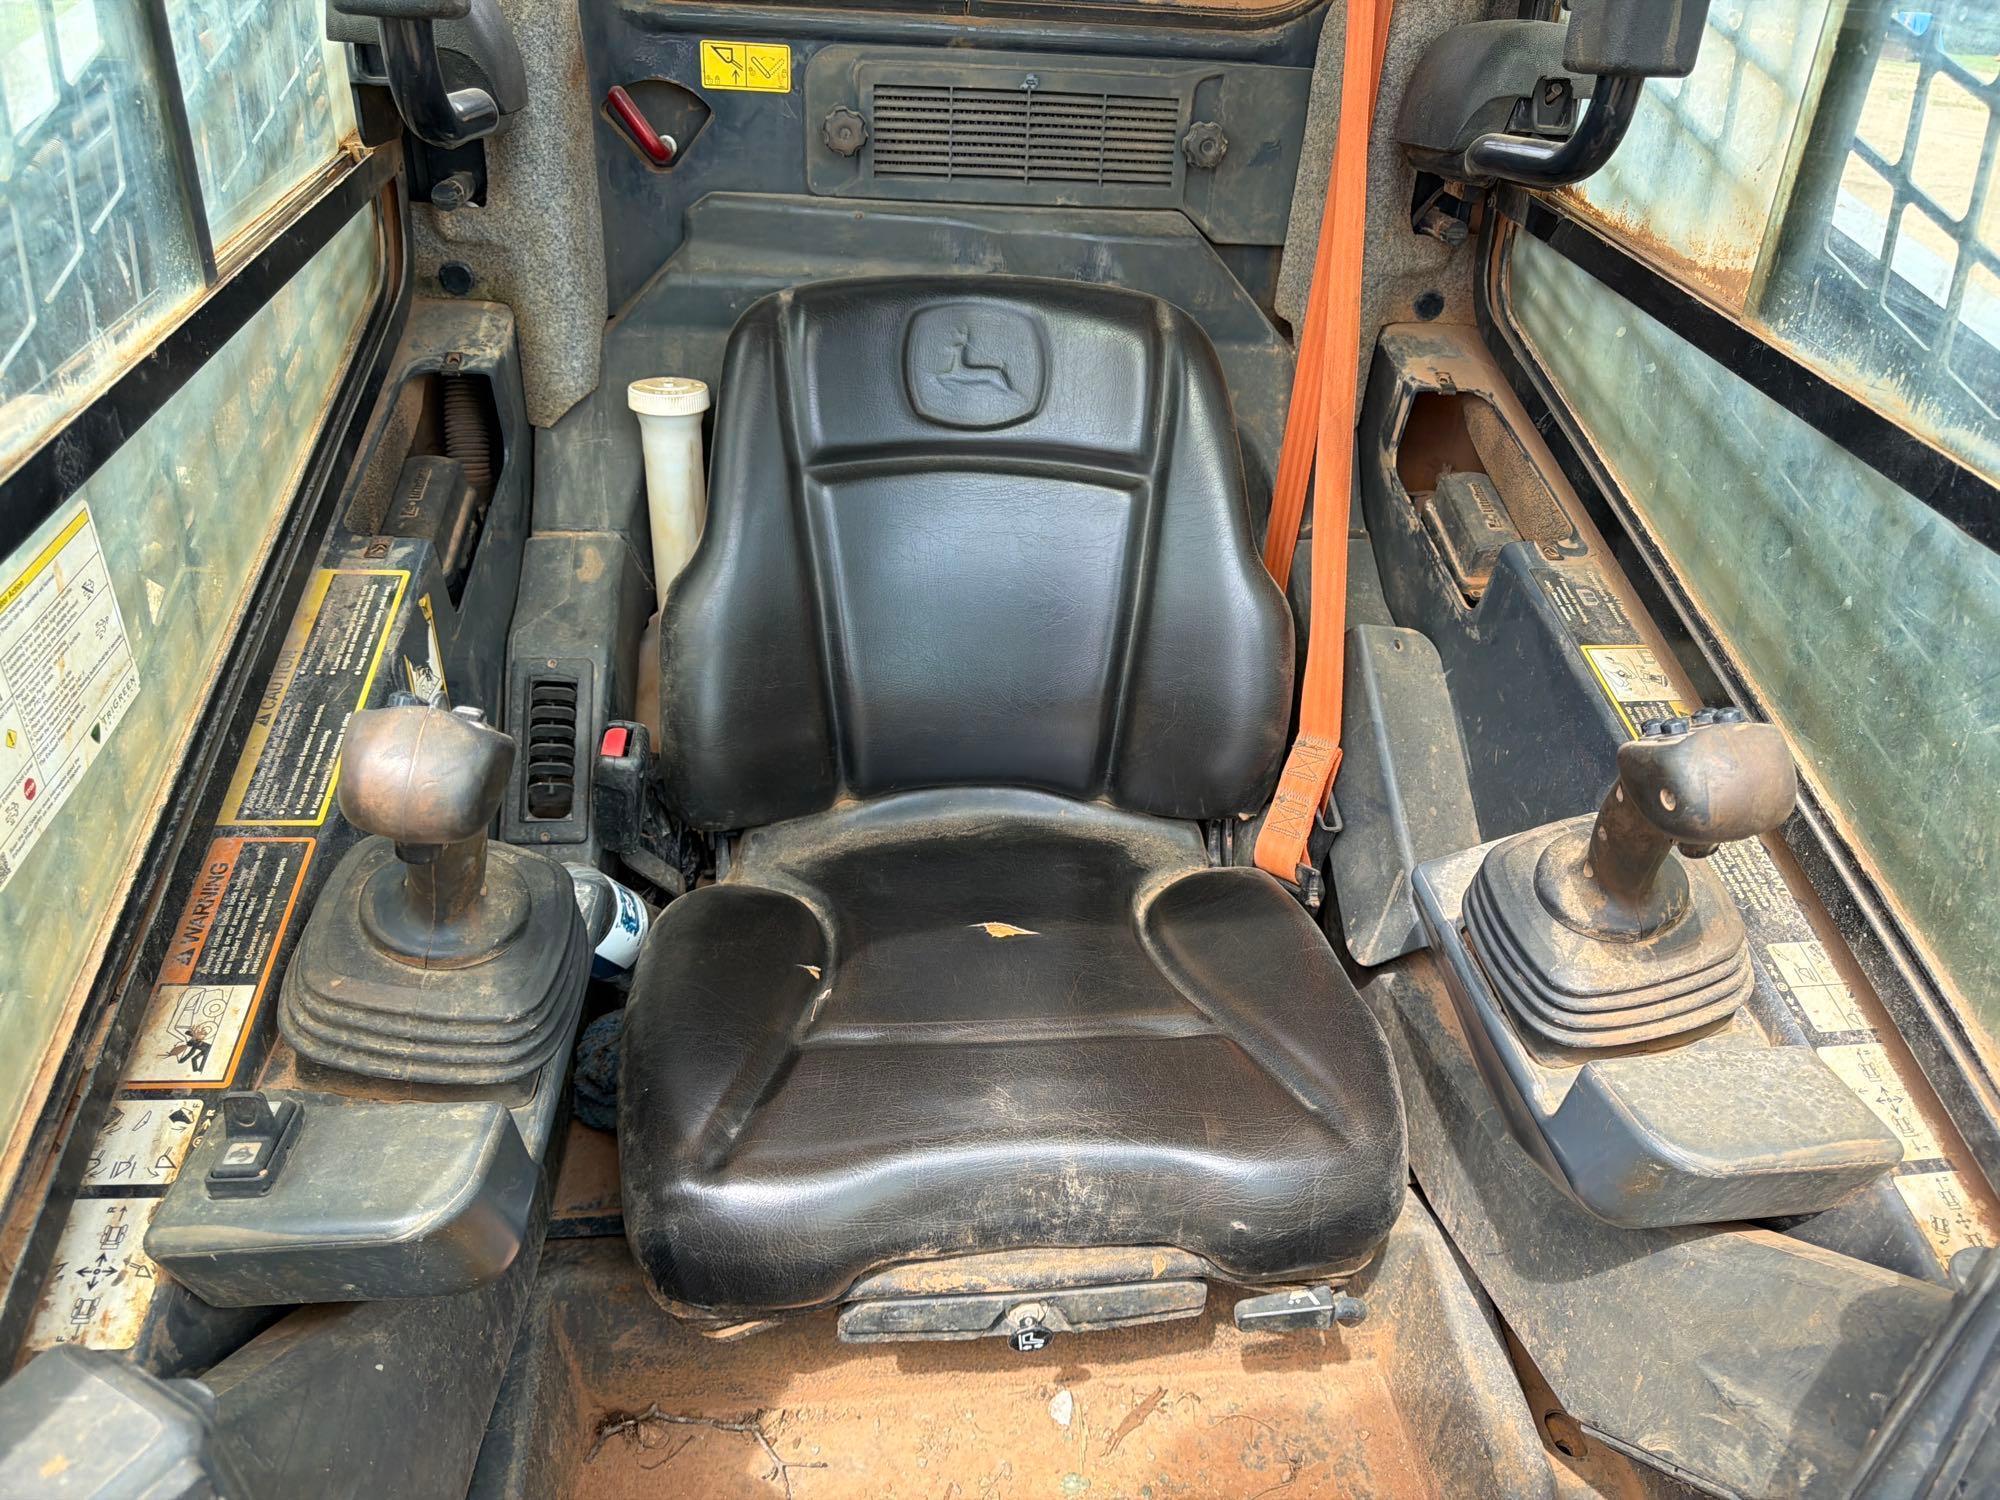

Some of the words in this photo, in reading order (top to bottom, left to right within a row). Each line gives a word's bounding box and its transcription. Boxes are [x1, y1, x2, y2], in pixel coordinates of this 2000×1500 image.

[1605, 603, 1625, 624] Manual
[261, 649, 298, 711] CAUTION
[100, 674, 137, 725] TRIGREEN
[254, 845, 267, 859] with
[243, 860, 262, 887] machine
[268, 857, 290, 886] complete
[179, 862, 230, 944] WARNING
[238, 888, 251, 900] this
[265, 887, 278, 897] for
[228, 901, 246, 925] around
[242, 894, 259, 917] raised.
[256, 897, 274, 922] Manual
[199, 949, 218, 974] Always
[209, 926, 226, 947] install
[218, 906, 234, 925] boom
[226, 891, 240, 905] lock
[227, 926, 236, 934] or
[235, 918, 250, 938] boom
[223, 935, 233, 945] on
[225, 939, 242, 961] loader
[242, 923, 267, 959] Operator's
[210, 945, 230, 974] working
[220, 962, 233, 974] the
[237, 960, 251, 974] See
